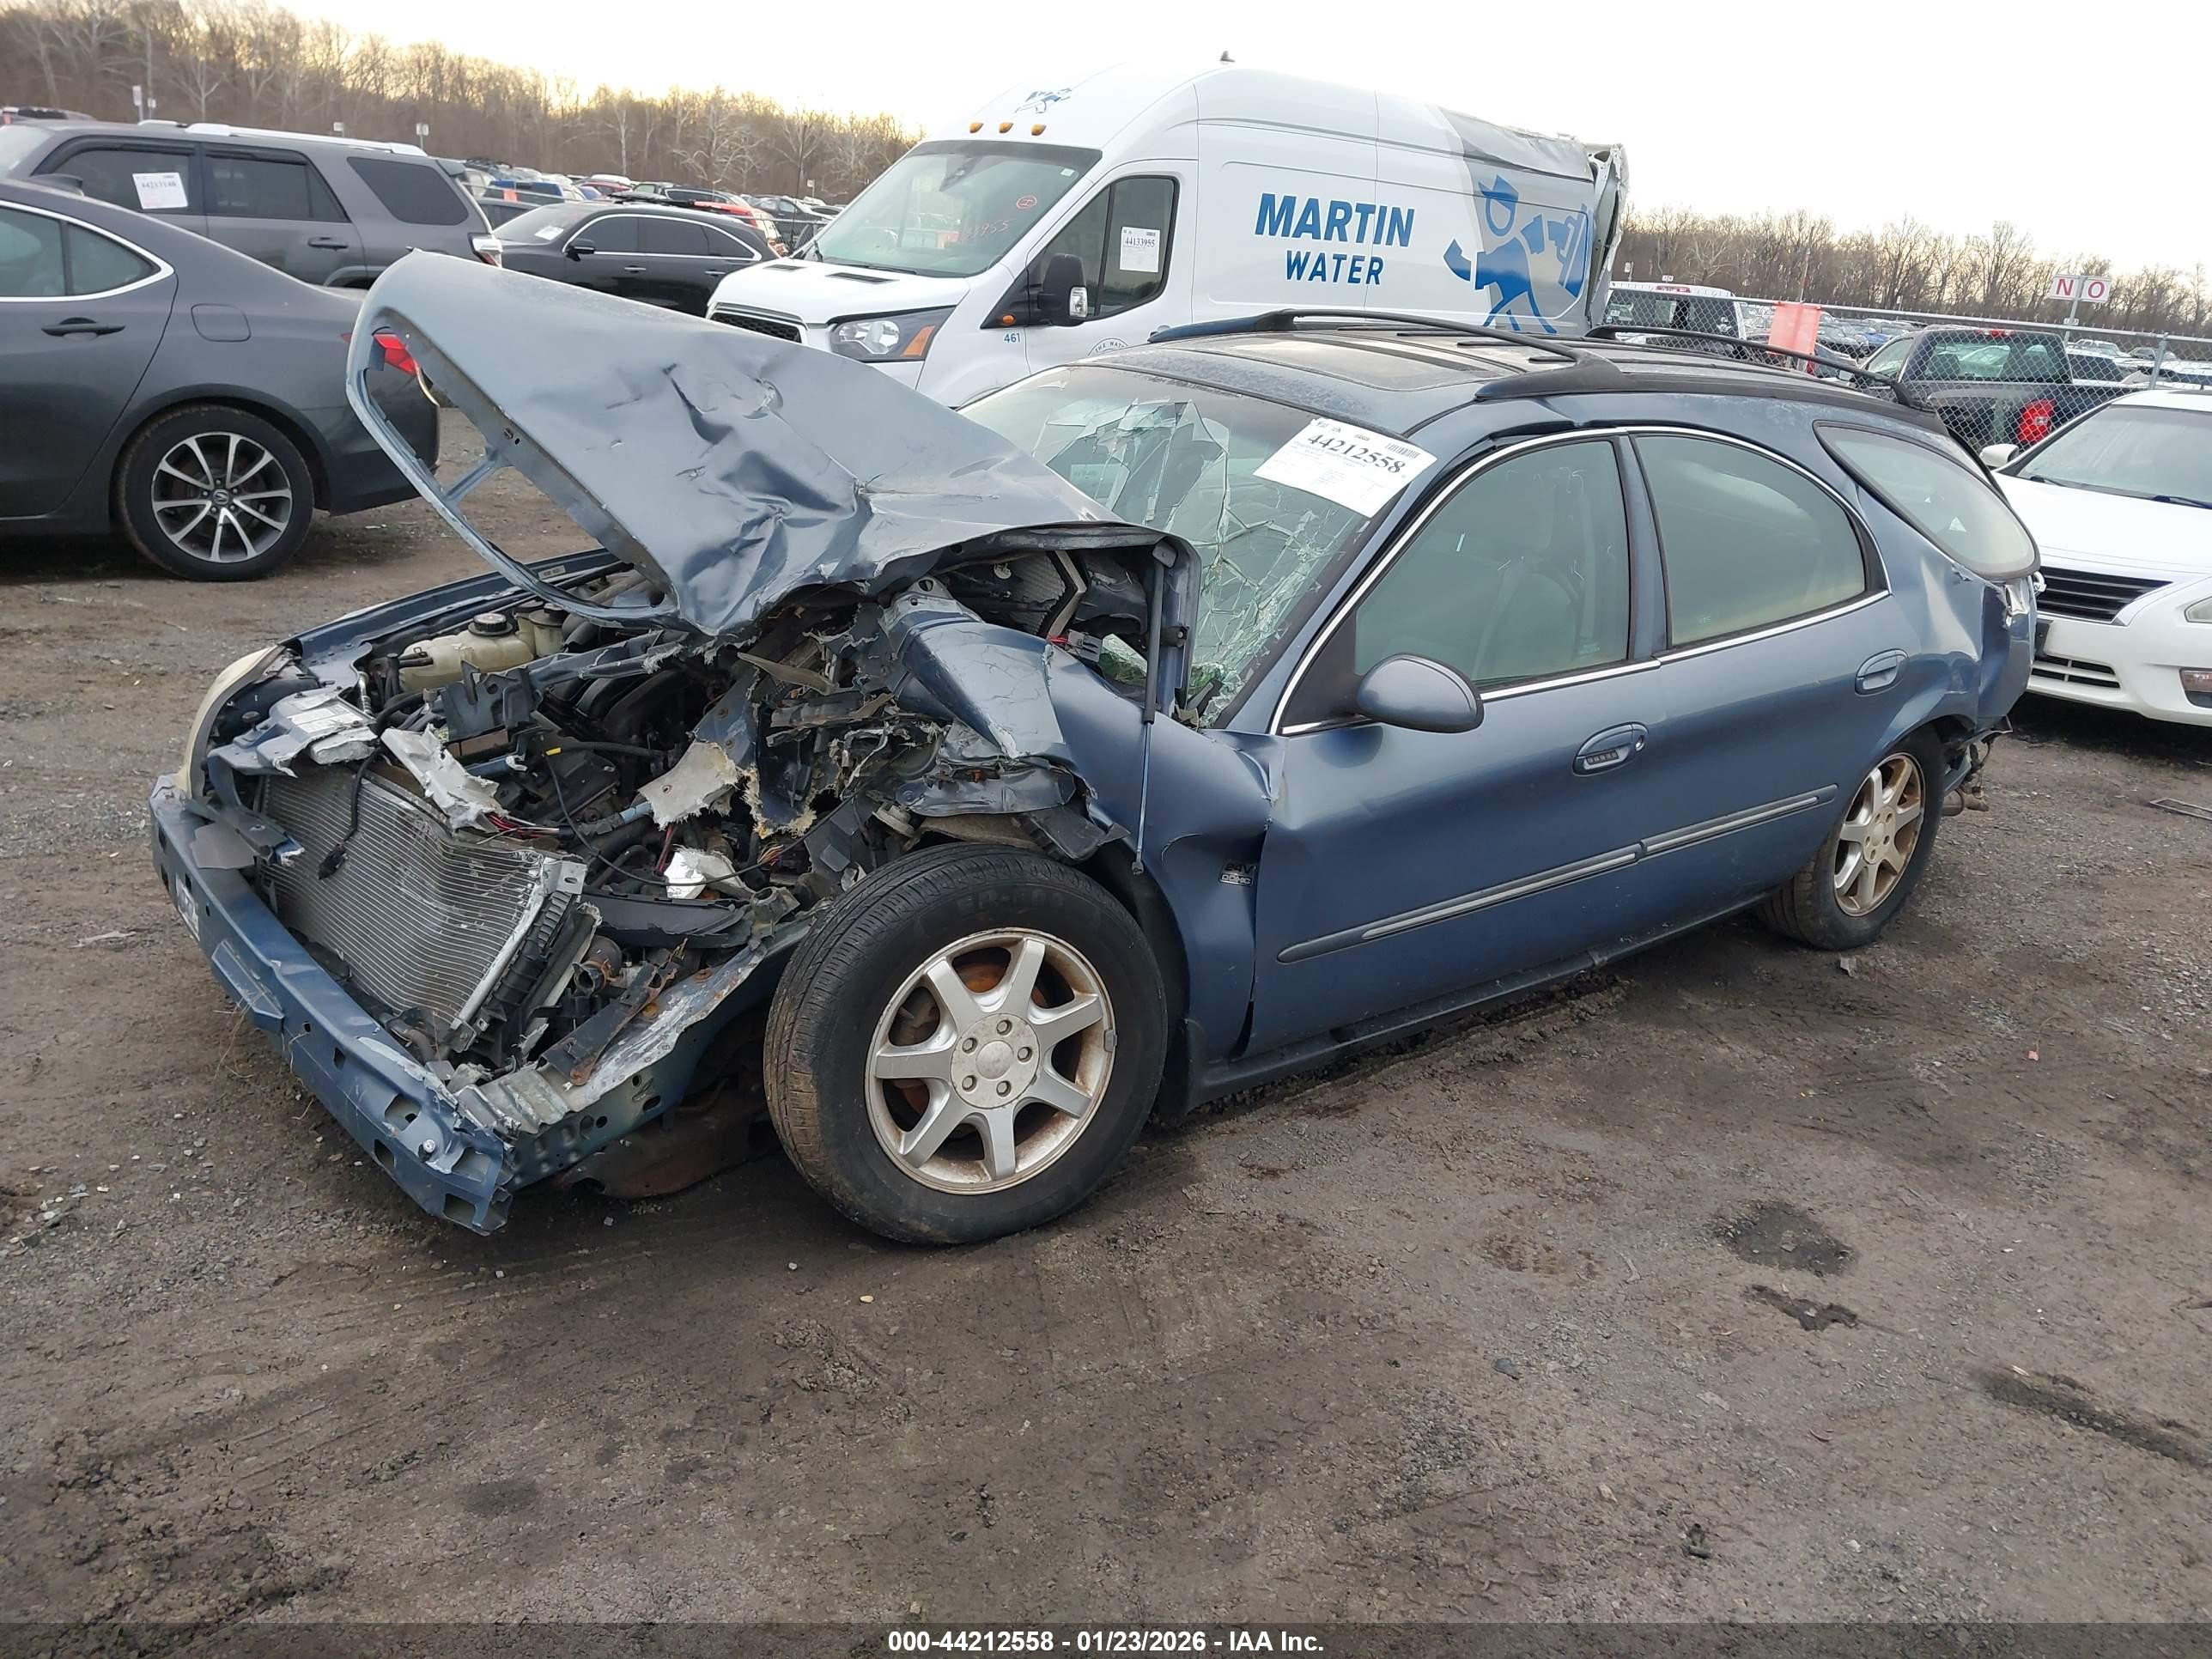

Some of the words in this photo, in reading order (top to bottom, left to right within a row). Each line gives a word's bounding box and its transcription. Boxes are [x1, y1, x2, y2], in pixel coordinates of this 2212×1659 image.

[1255, 192, 1415, 247] MARTIN
[1125, 236, 1155, 247] 44133955
[1286, 250, 1384, 285] WATER
[2056, 278, 2075, 296] N
[2087, 281, 2106, 298] O
[1003, 332, 1021, 343] 461
[1308, 434, 1407, 474] 44212558
[1221, 874, 1252, 884] DOHC
